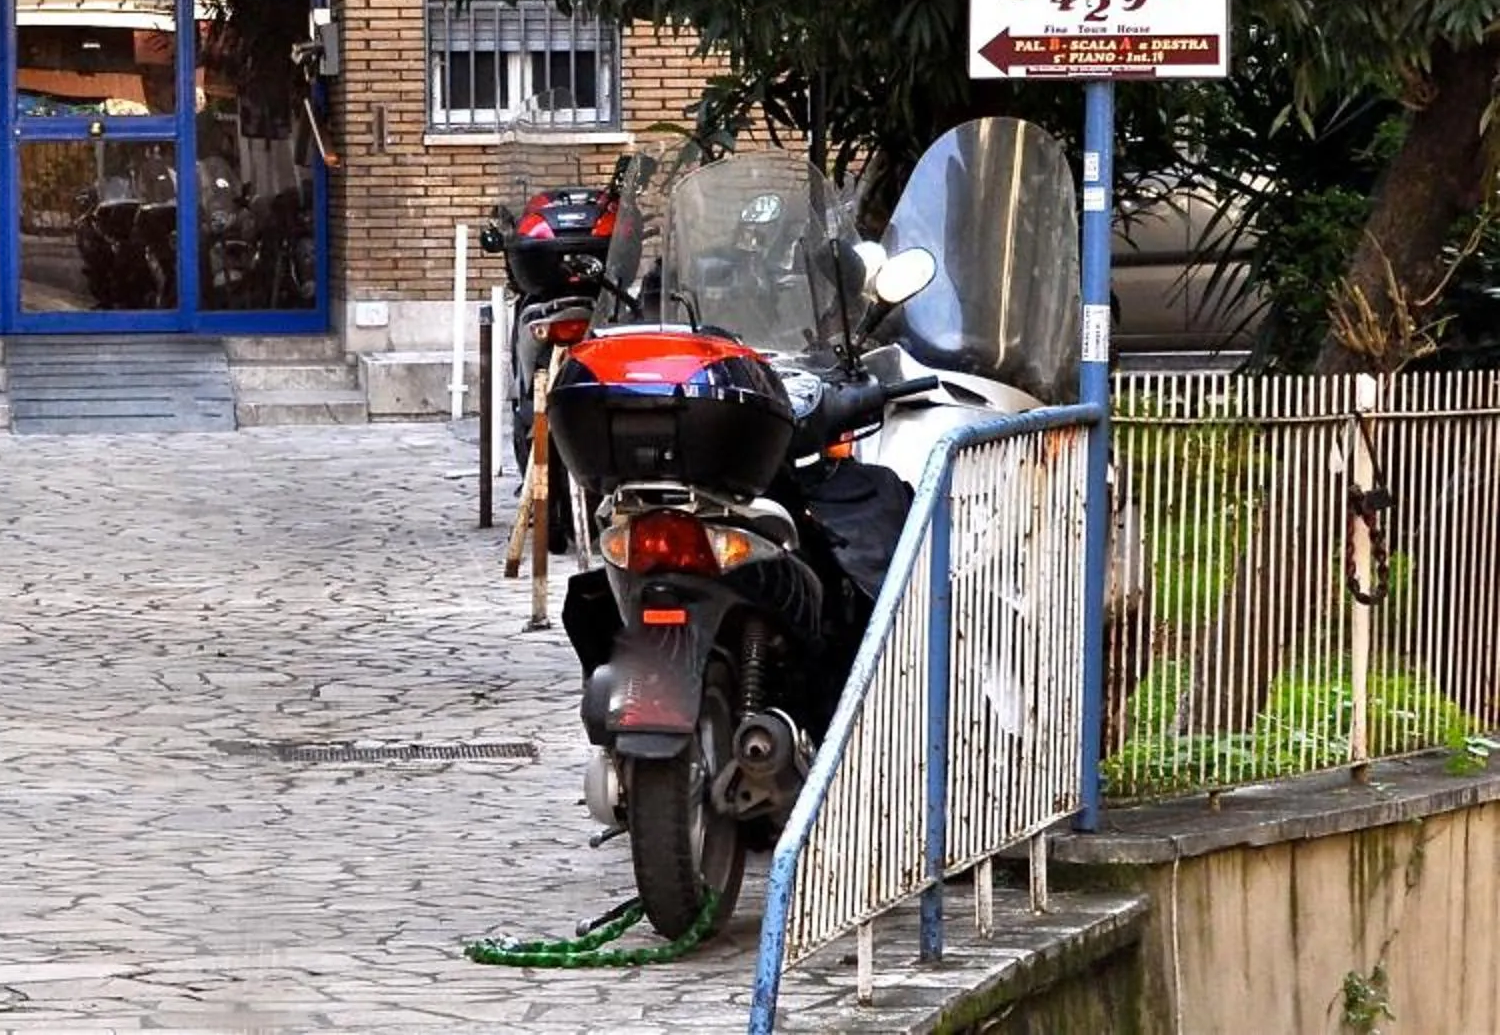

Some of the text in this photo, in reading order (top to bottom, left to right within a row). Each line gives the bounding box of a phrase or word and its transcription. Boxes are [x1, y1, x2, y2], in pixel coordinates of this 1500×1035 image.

[1078, 25, 1107, 33] Town
[1117, 25, 1150, 33] House
[1015, 40, 1046, 51] PAL.
[1069, 40, 1117, 50] SCALA
[1151, 39, 1209, 50] DESTRA
[1069, 52, 1116, 63] PIANO
